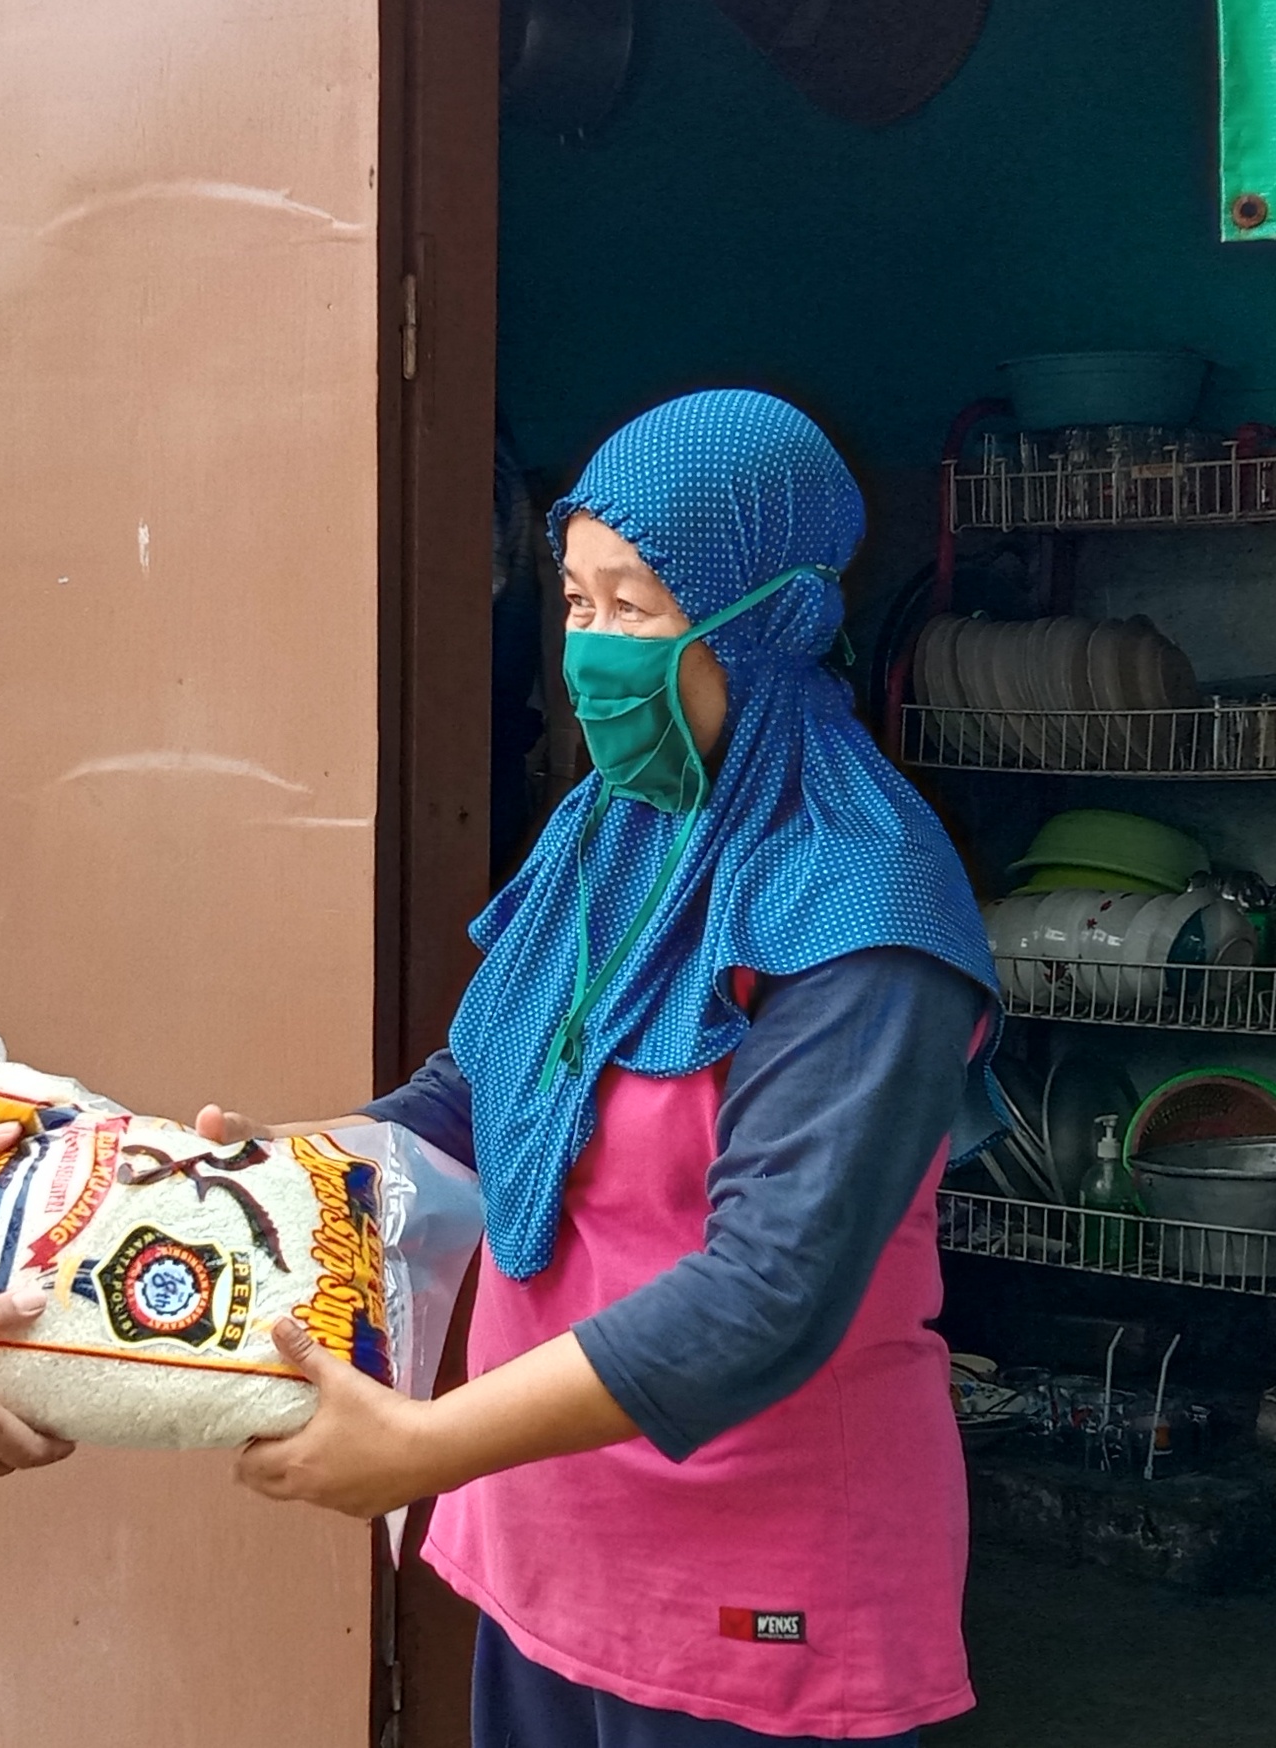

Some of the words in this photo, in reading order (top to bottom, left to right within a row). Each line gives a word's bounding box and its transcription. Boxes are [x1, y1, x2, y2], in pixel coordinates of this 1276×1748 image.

[49, 1165, 115, 1245] KUJANG
[114, 1232, 156, 1274] WARTA
[151, 1271, 187, 1309] 18th
[225, 1263, 250, 1340] PERS
